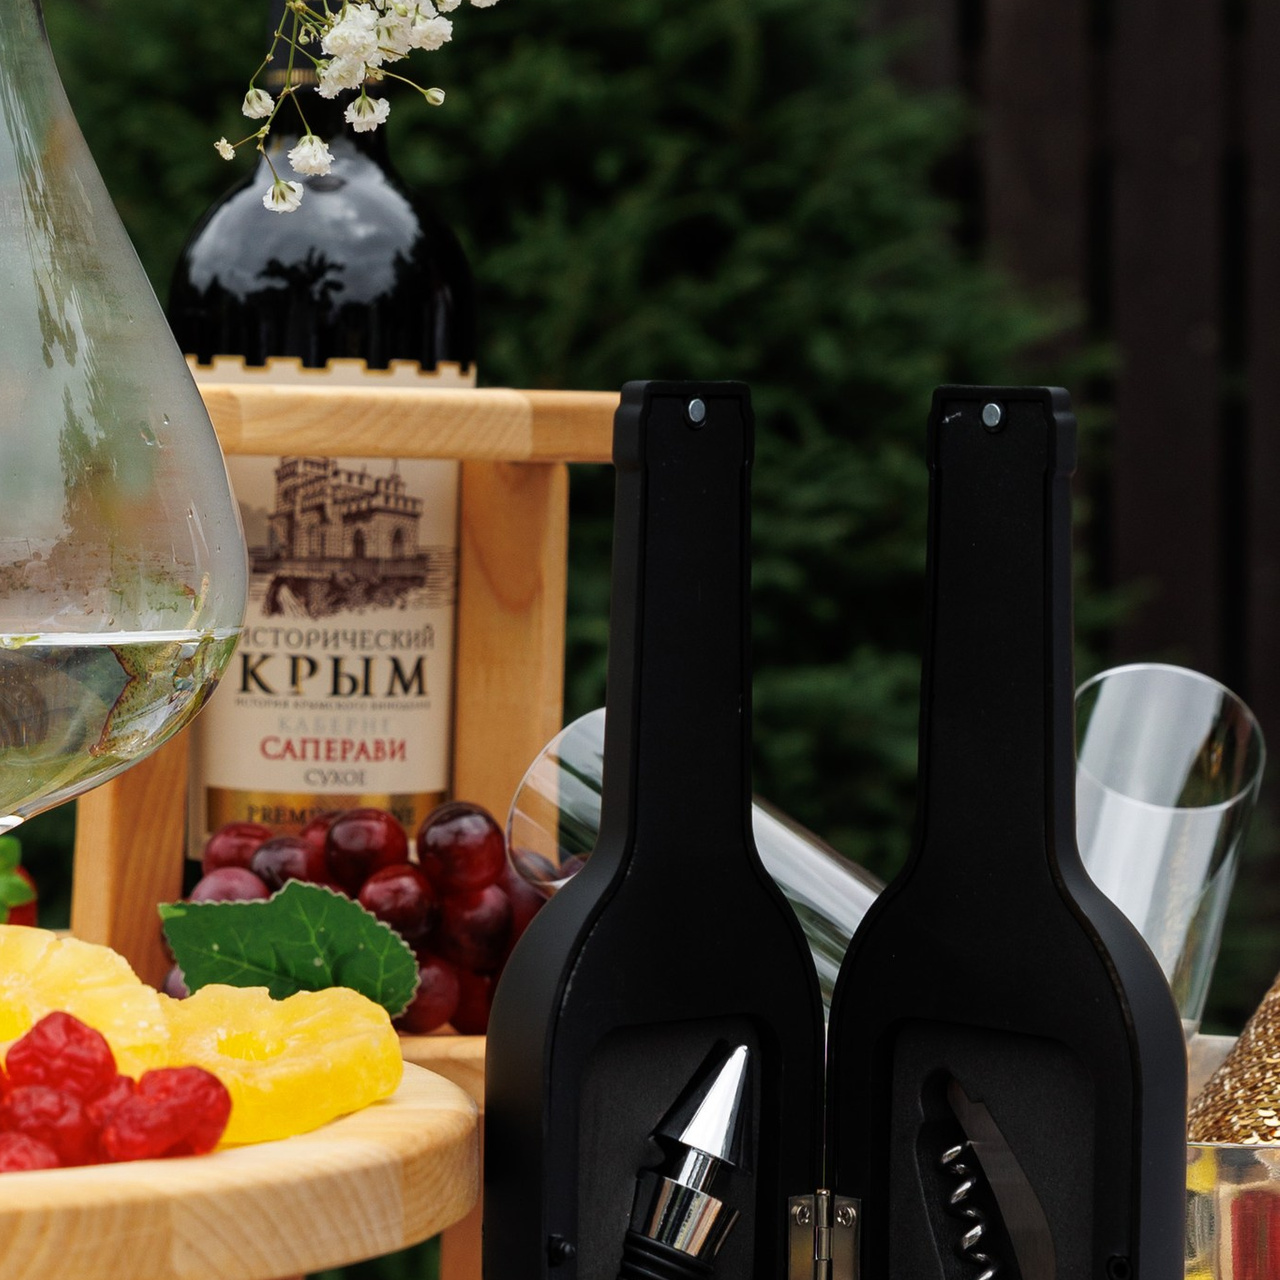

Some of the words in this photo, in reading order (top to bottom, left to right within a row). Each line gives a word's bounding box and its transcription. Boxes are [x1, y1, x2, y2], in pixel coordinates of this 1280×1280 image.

[241, 624, 435, 651] ИСТОРИЧЕСКИЙ
[239, 651, 427, 697] КРЫМ
[260, 735, 407, 763] САПЕРАВИ
[304, 768, 365, 787] СУХОЕ
